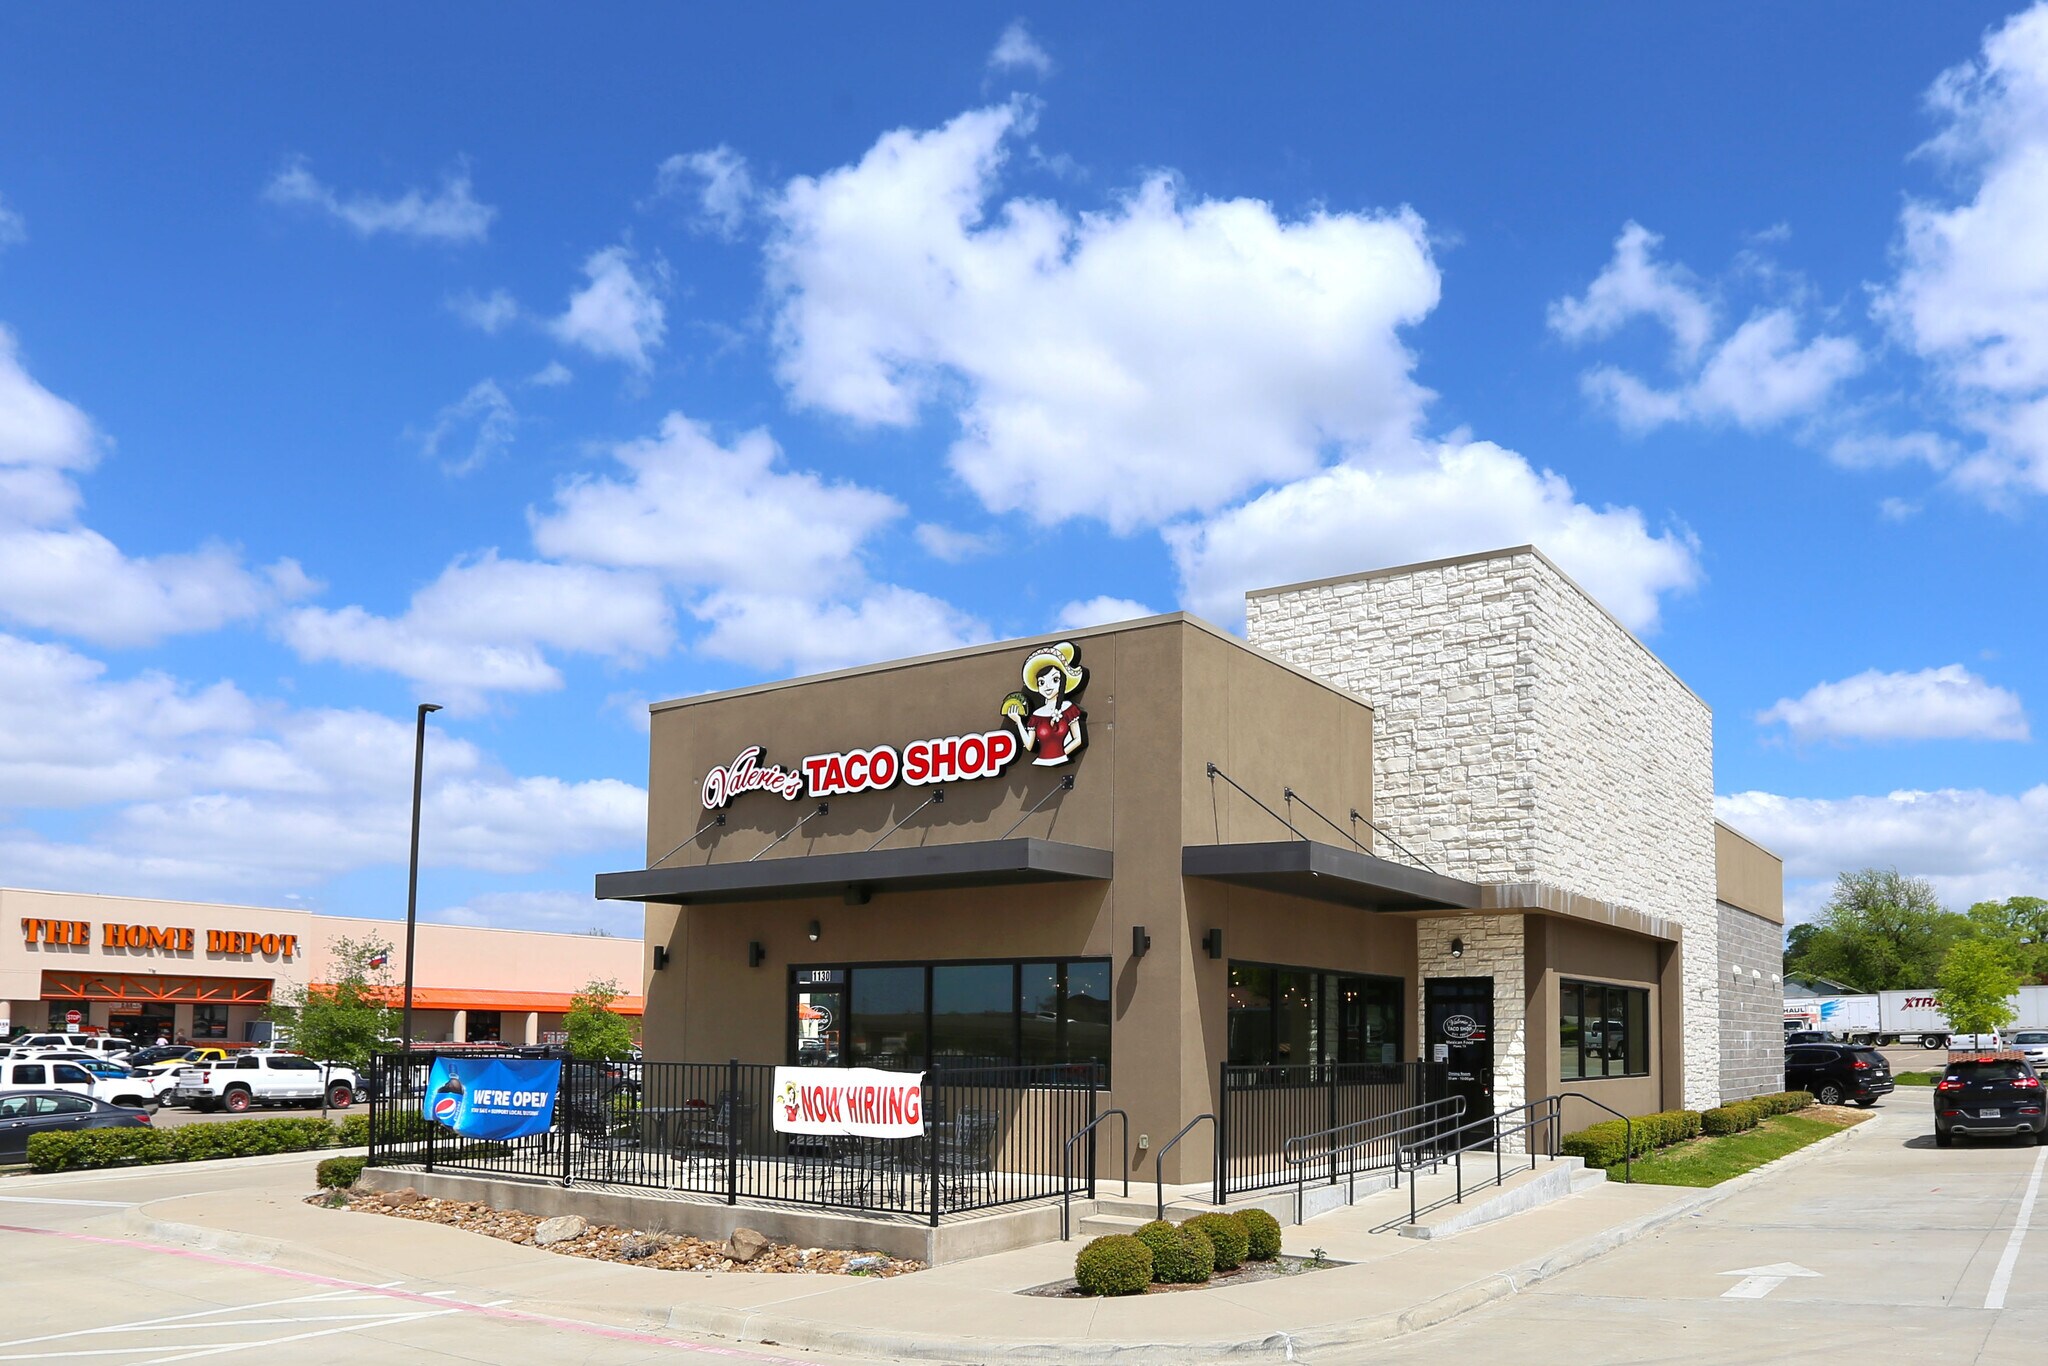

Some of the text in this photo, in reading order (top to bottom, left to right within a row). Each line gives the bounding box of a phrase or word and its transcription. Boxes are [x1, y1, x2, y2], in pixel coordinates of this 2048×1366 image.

[703, 735, 1012, 809] Valerie's TACO SHOP
[21, 917, 298, 956] THE HOME DEPOT
[812, 970, 831, 981] 1130
[1900, 996, 1943, 1011] XTRA
[473, 1089, 549, 1108] WE'RE OPEN
[801, 1086, 844, 1123] NOW
